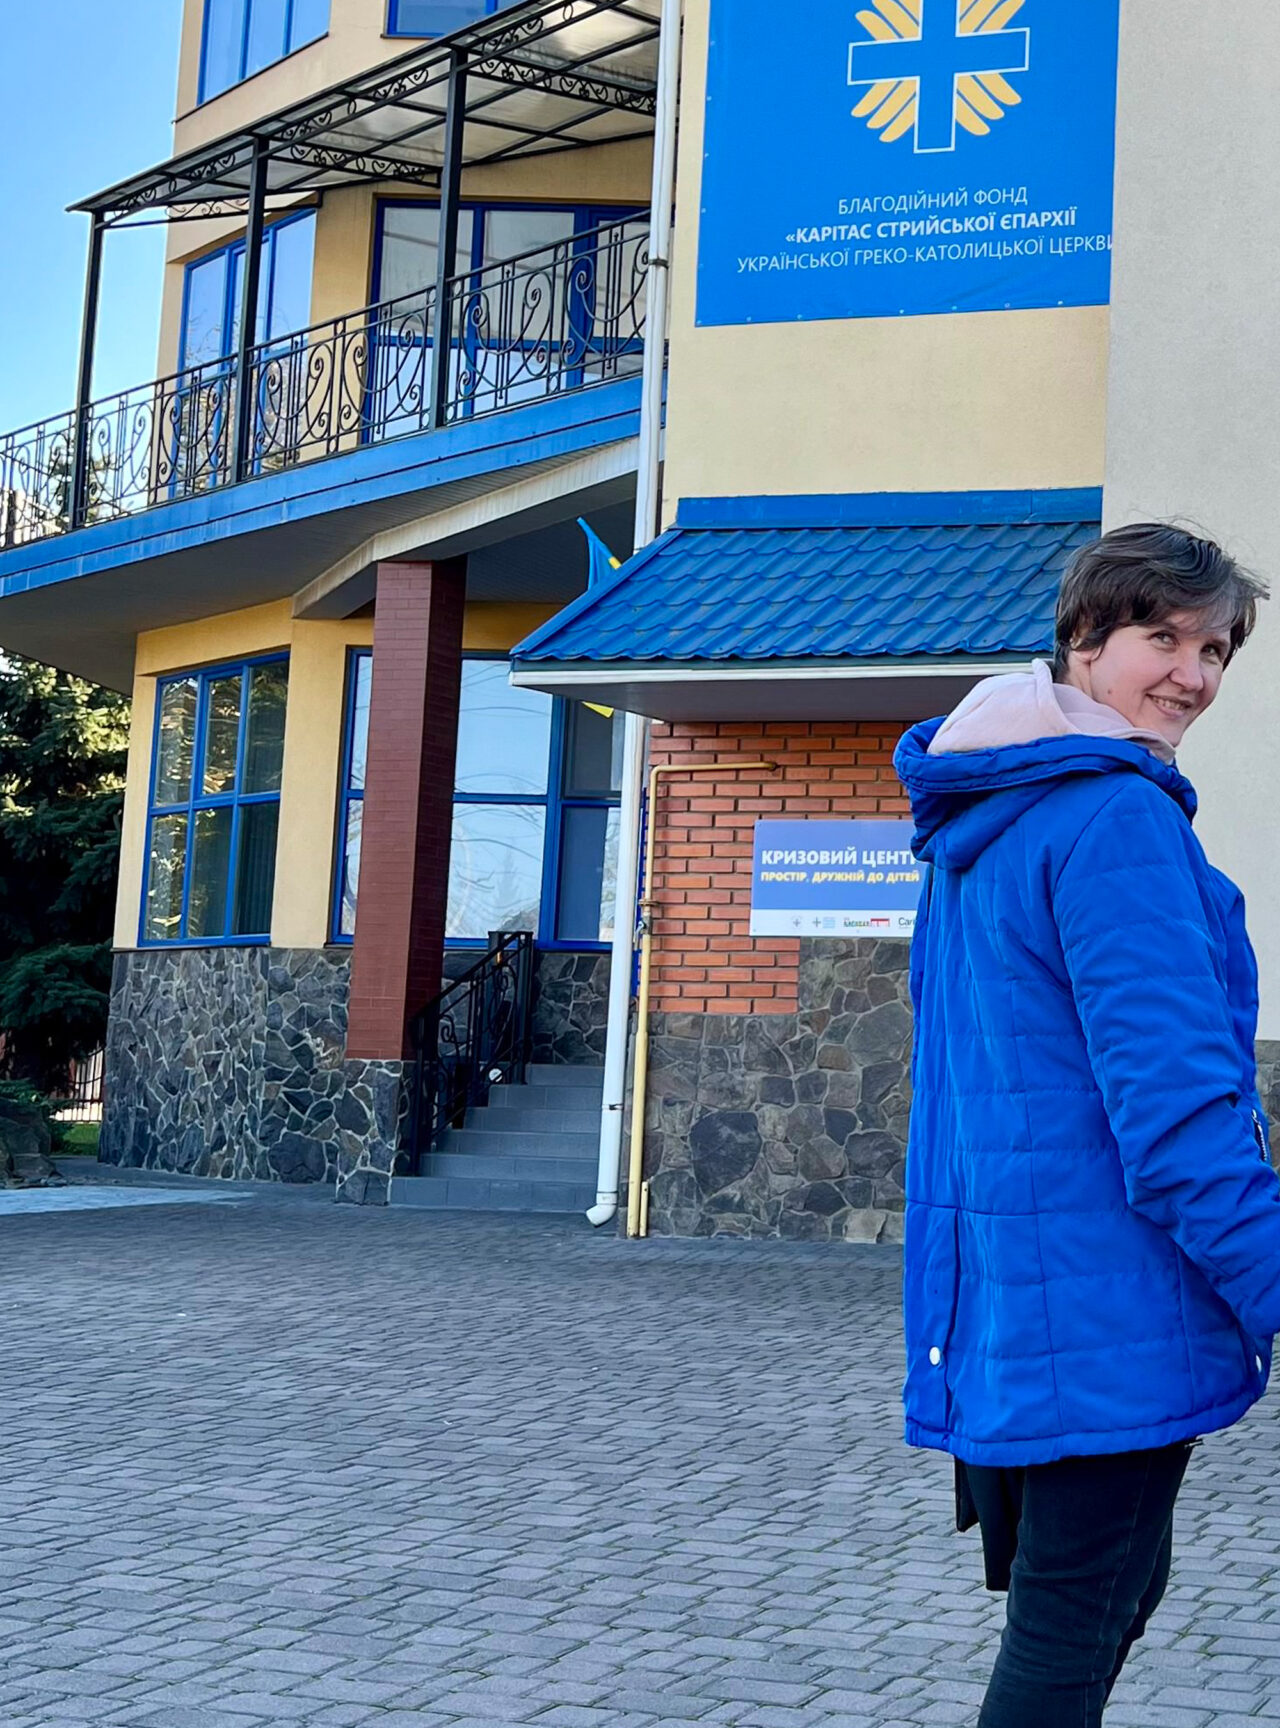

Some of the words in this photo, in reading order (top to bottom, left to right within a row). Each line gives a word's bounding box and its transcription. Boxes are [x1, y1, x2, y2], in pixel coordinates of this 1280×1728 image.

[838, 187, 969, 215] БЛАГОДІЙНИЙ
[973, 186, 1028, 208] ФОНД
[785, 223, 872, 243] «КАРІТАС
[877, 214, 995, 239] СТРИЙСЬКОЇ
[1000, 206, 1077, 230] ЄПАРХІЇ
[737, 248, 849, 273] УКРАЇНСЬКОЇ
[854, 239, 1044, 265] ГРЕКО-КАТОЛИЦЬКОЇ
[761, 846, 857, 865] КРИЗОВИЙ
[812, 870, 865, 883] ДРУЖНІЙ
[866, 871, 884, 883] ДО
[886, 870, 920, 883] ДІТЕЙ
